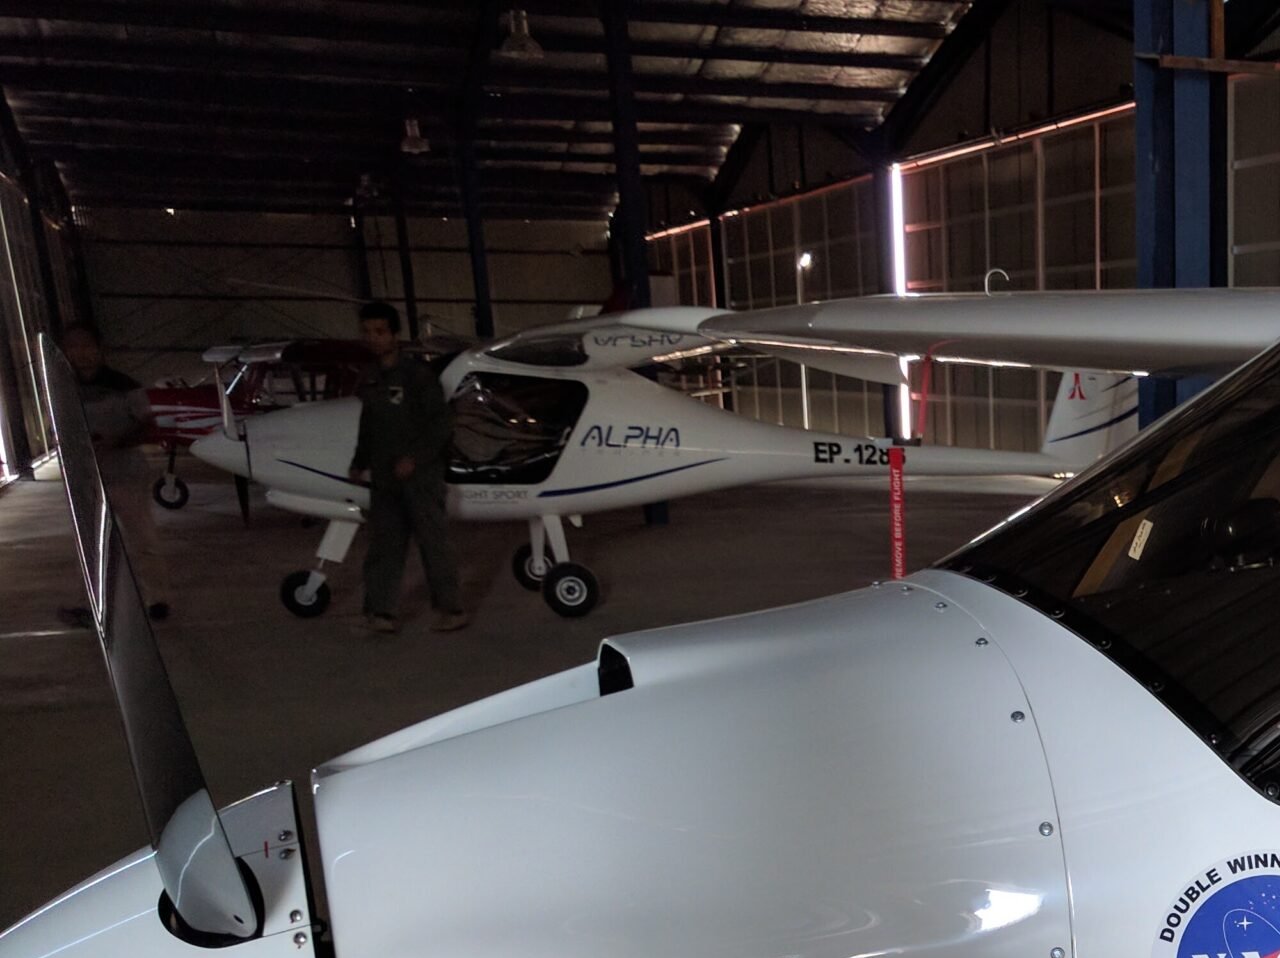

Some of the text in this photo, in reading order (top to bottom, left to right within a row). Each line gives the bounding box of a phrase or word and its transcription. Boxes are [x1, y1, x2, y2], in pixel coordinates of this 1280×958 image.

[580, 425, 680, 448] ALPHA
[813, 442, 906, 465] EP.128
[891, 468, 904, 579] REMOVE BEFORE FLIGHT
[1159, 868, 1222, 943] DOUBLE
